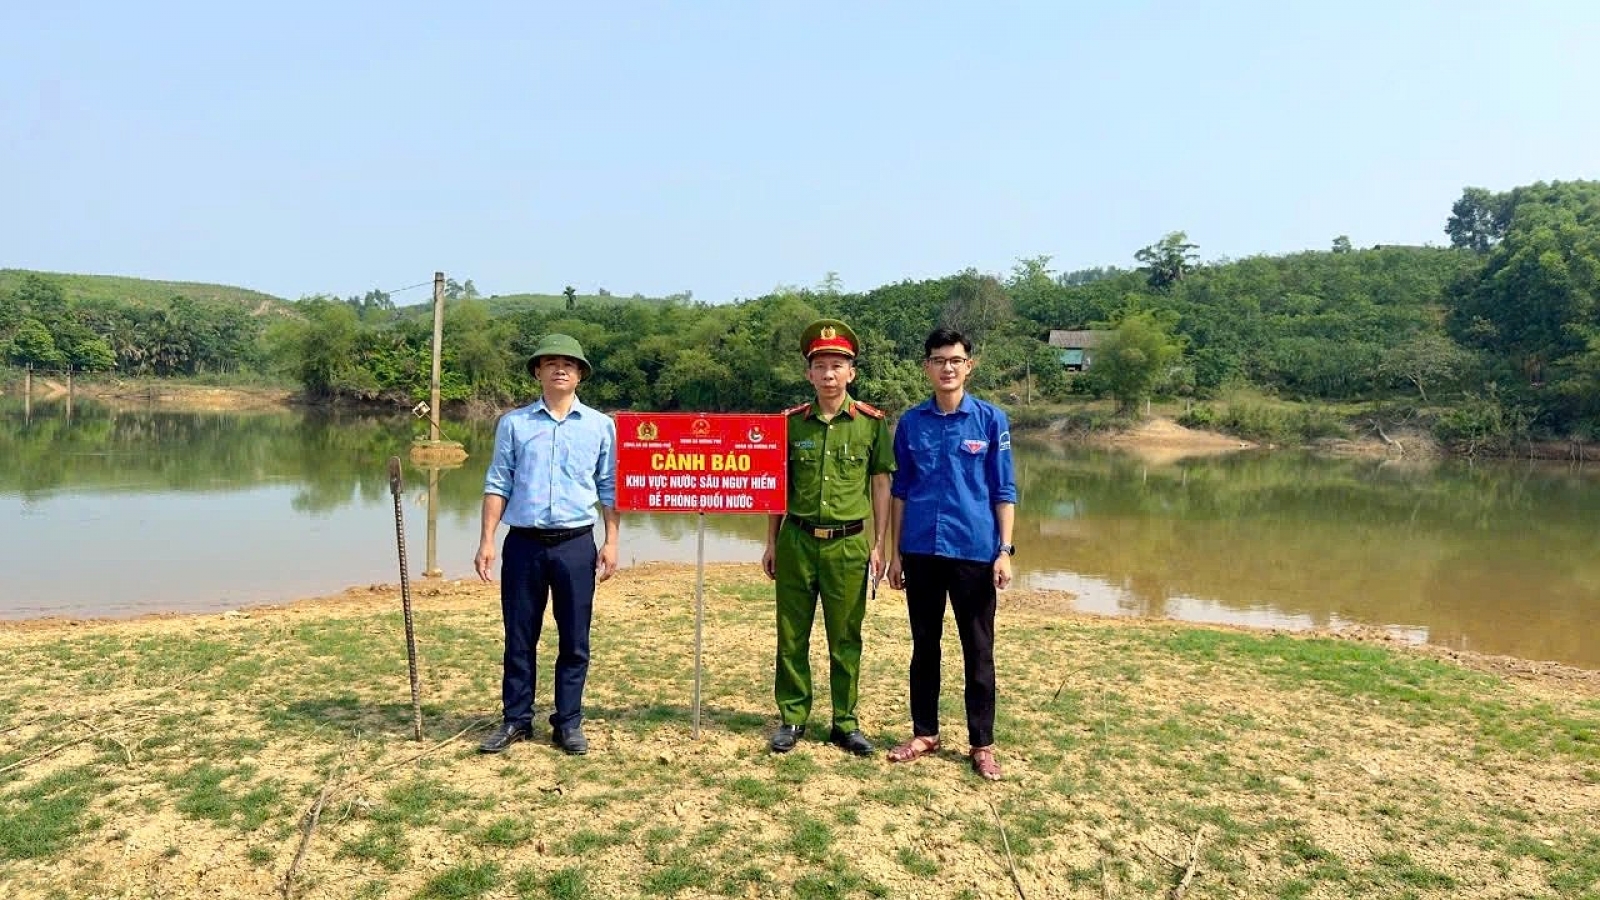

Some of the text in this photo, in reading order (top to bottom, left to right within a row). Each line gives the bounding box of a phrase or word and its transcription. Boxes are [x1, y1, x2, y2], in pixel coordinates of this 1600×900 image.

[651, 448, 750, 471] CẢNH BÁO
[626, 475, 645, 487] KHU
[648, 475, 668, 490] VỰC
[669, 474, 696, 488] NƯỚC
[699, 474, 719, 488] SÂU
[722, 476, 749, 489] NGUY
[664, 491, 697, 507] PHÒNG
[725, 493, 753, 508] NƯỚC
